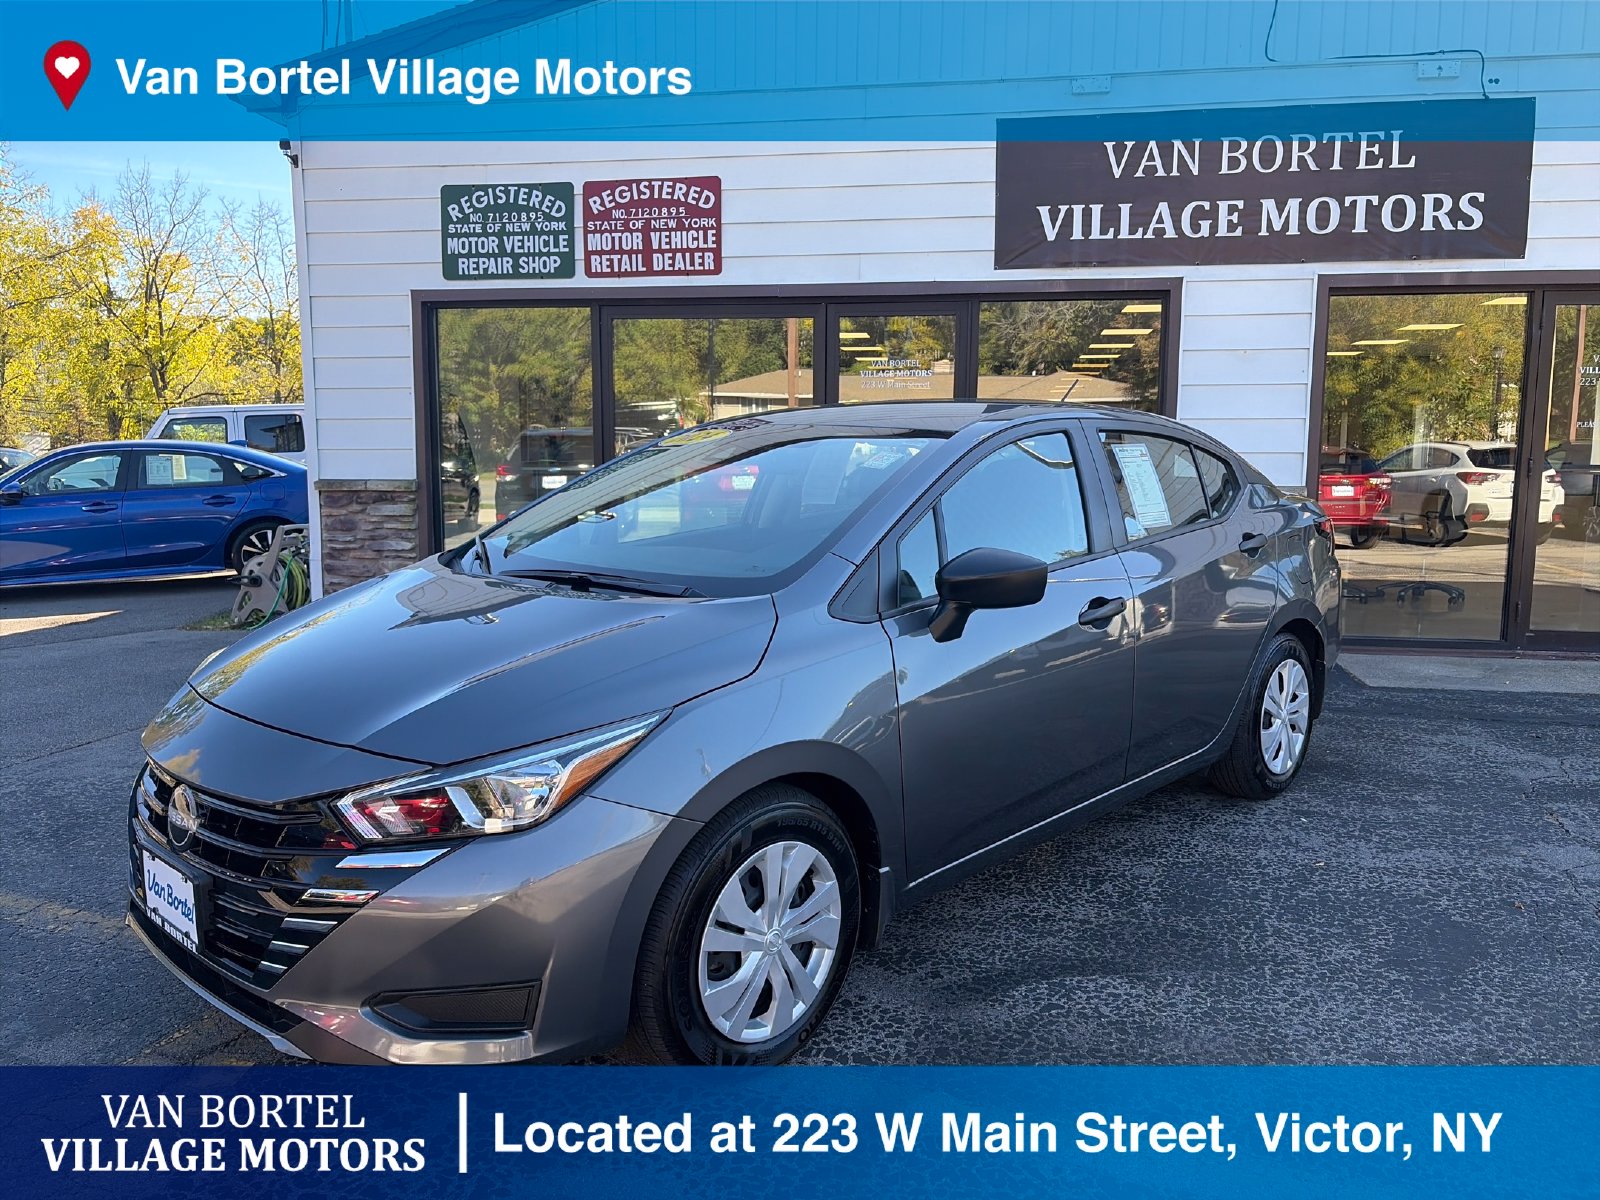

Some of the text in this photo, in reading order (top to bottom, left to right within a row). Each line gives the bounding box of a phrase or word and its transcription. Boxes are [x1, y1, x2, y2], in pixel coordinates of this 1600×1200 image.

[1103, 130, 1417, 180] VAN BORTEL
[447, 186, 566, 222] REGISTERED
[588, 181, 716, 215] REGISTERED
[470, 212, 544, 223] NO. 7120895
[612, 207, 686, 219] NO. 7120895
[1036, 192, 1485, 242] VILLAGE MOTORS
[448, 221, 567, 234] STATE OF NEW YORK
[587, 218, 717, 231] STATE OF NEW YORK
[447, 235, 570, 255] MOTOR VEHICLE
[587, 230, 717, 251] MOTOR VEHICLE
[458, 256, 561, 275] REPAIR SHOP
[590, 252, 715, 273] RETAIL DEALER
[889, 359, 922, 367] BORTEL
[860, 369, 933, 378] VILLAGE MOTORS
